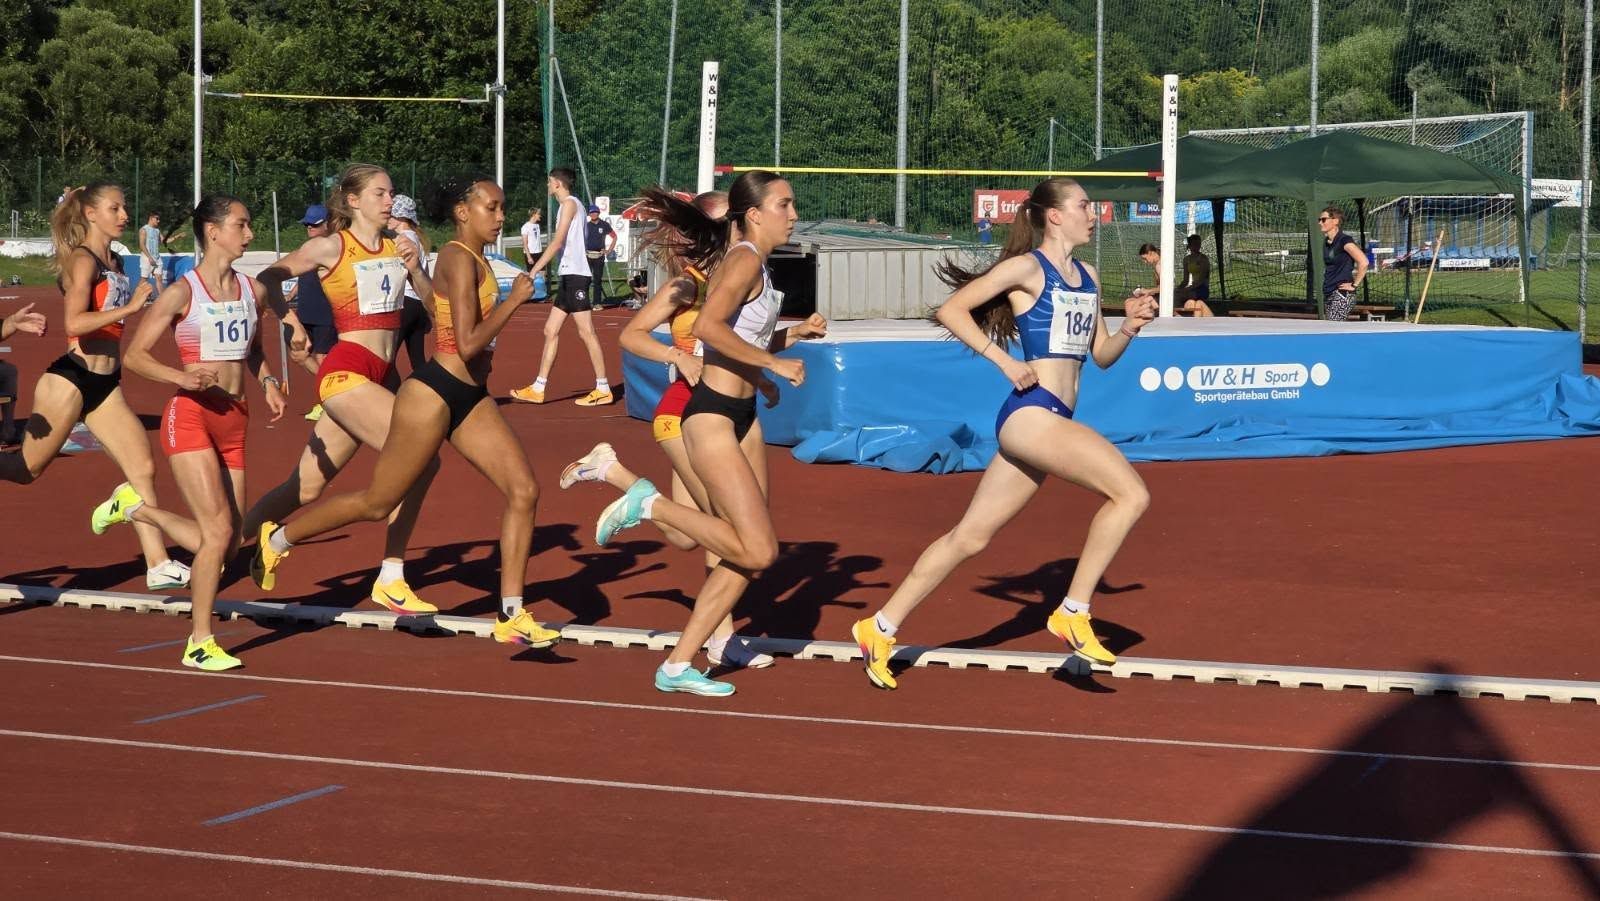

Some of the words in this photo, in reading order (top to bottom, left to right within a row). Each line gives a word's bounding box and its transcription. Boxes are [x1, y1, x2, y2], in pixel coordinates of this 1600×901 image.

[381, 274, 391, 295] 4
[215, 319, 249, 343] 161
[1065, 310, 1093, 336] 184
[1200, 368, 1219, 386] W
[1223, 368, 1237, 386] &
[1241, 367, 1256, 385] H
[1265, 370, 1299, 385] Sport
[1194, 390, 1269, 403] Sportgerätebau
[1271, 389, 1300, 400] GmbH
